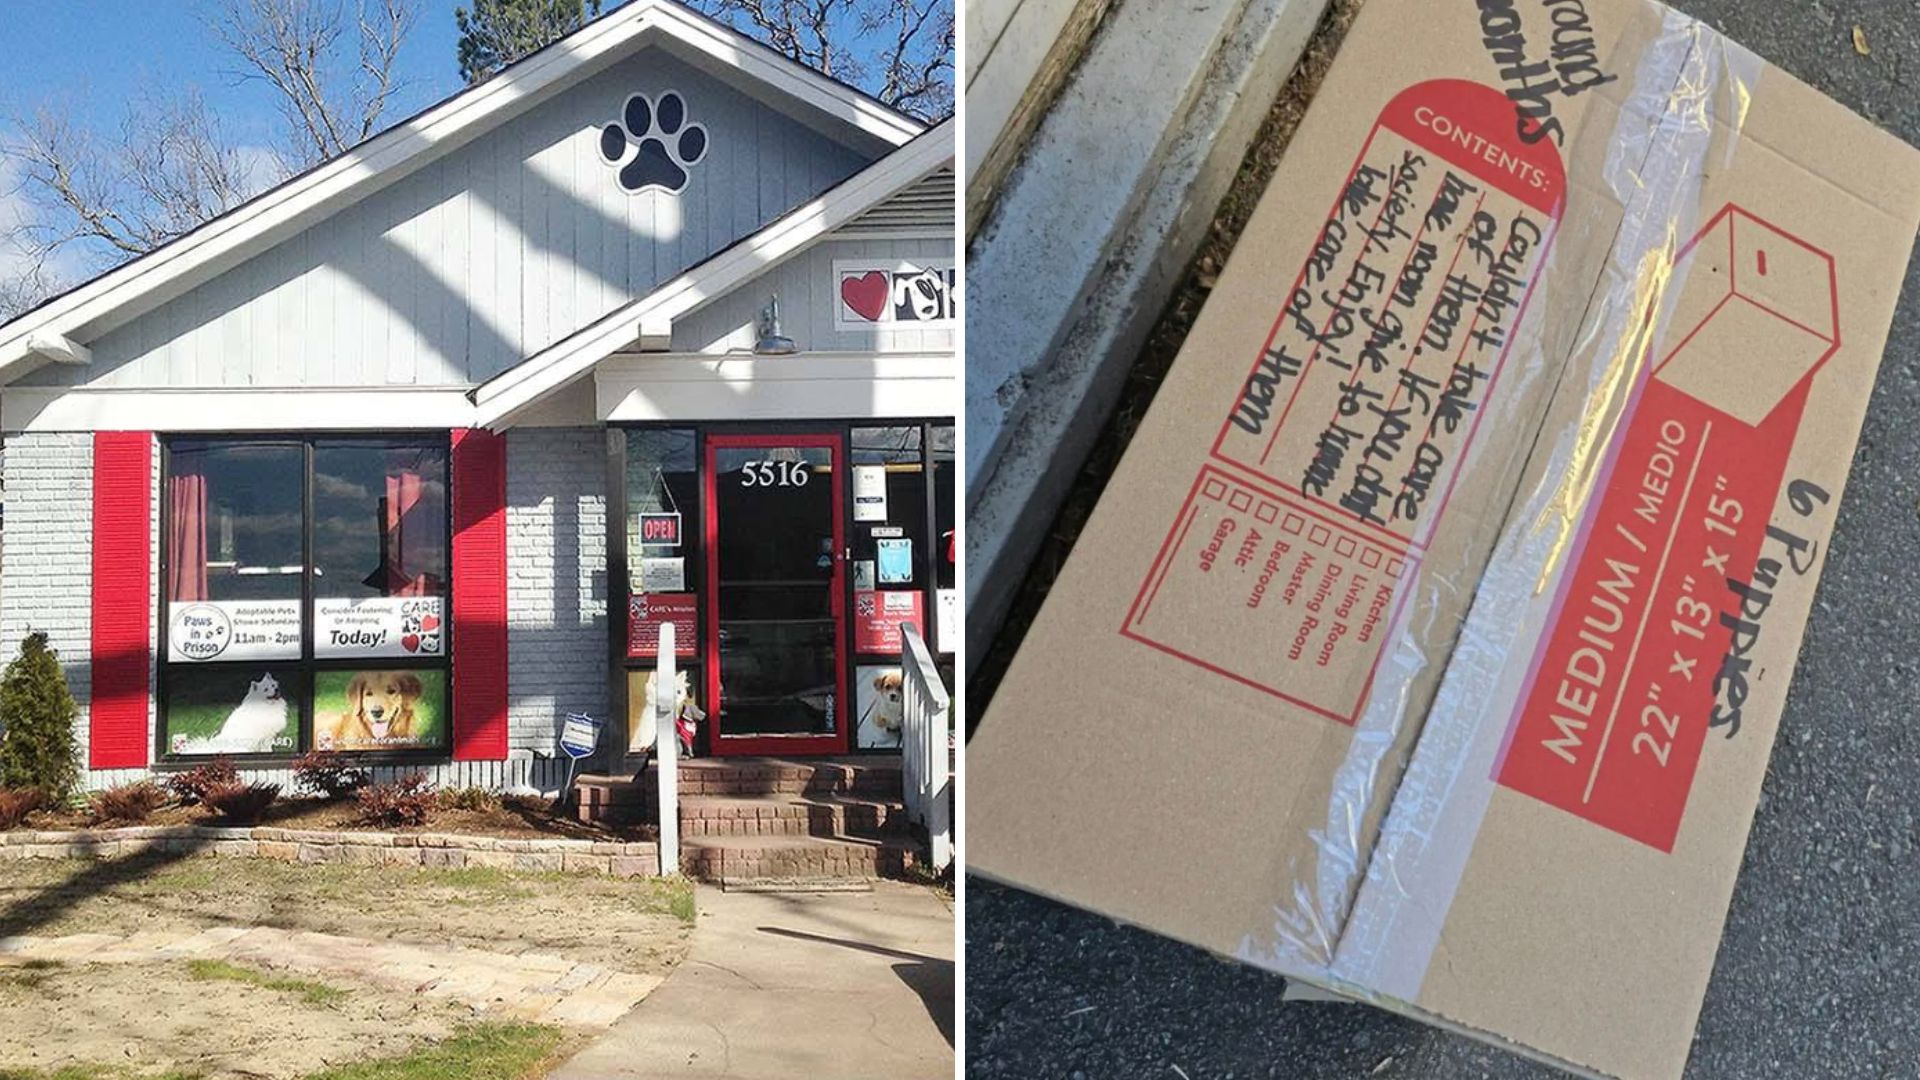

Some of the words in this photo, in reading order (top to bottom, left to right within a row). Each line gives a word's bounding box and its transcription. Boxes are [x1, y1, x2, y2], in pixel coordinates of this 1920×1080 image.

[1414, 106, 1550, 192] CONTENTS:
[1425, 171, 1477, 234] have
[1304, 218, 1347, 287] care
[1467, 210, 1501, 273] of
[1472, 215, 1541, 352] Couldn't
[1283, 287, 1319, 342] of
[1312, 259, 1387, 371] Enjoy!
[1358, 307, 1407, 374] give
[1414, 274, 1482, 356] them.
[1227, 345, 1303, 436] them
[1338, 380, 1383, 417] to
[1399, 368, 1440, 416] If
[1431, 362, 1489, 438] take
[1362, 401, 1411, 462] you
[740, 461, 809, 488] 5516
[1392, 442, 1443, 522] care
[1787, 478, 1831, 518] 6
[644, 519, 676, 540] OPEN
[1703, 475, 1745, 538] 15"
[1200, 517, 1237, 573] Garage
[1234, 527, 1263, 568] Attic
[1702, 545, 1730, 576] x
[1246, 539, 1291, 610] Bedroom
[1282, 551, 1317, 606] Master
[1306, 562, 1343, 614] Dining
[1334, 573, 1369, 621] Living
[1541, 556, 1641, 766] MEDIUM
[1616, 522, 1648, 552] /
[1633, 419, 1686, 525] MEDIO
[184, 615, 213, 627] Paws
[190, 628, 201, 640] in
[401, 600, 440, 614] CARE
[1357, 583, 1394, 644] Kitchen
[1670, 575, 1712, 641] 13"
[1709, 523, 1818, 740] Puppies
[183, 641, 219, 653] Prison
[234, 632, 266, 644] 11am
[275, 631, 300, 645] 2pm
[330, 629, 387, 648] Today!
[1288, 615, 1319, 661] Room
[1316, 622, 1348, 667] Room
[1669, 651, 1699, 681] x
[1632, 682, 1680, 768] 22"
